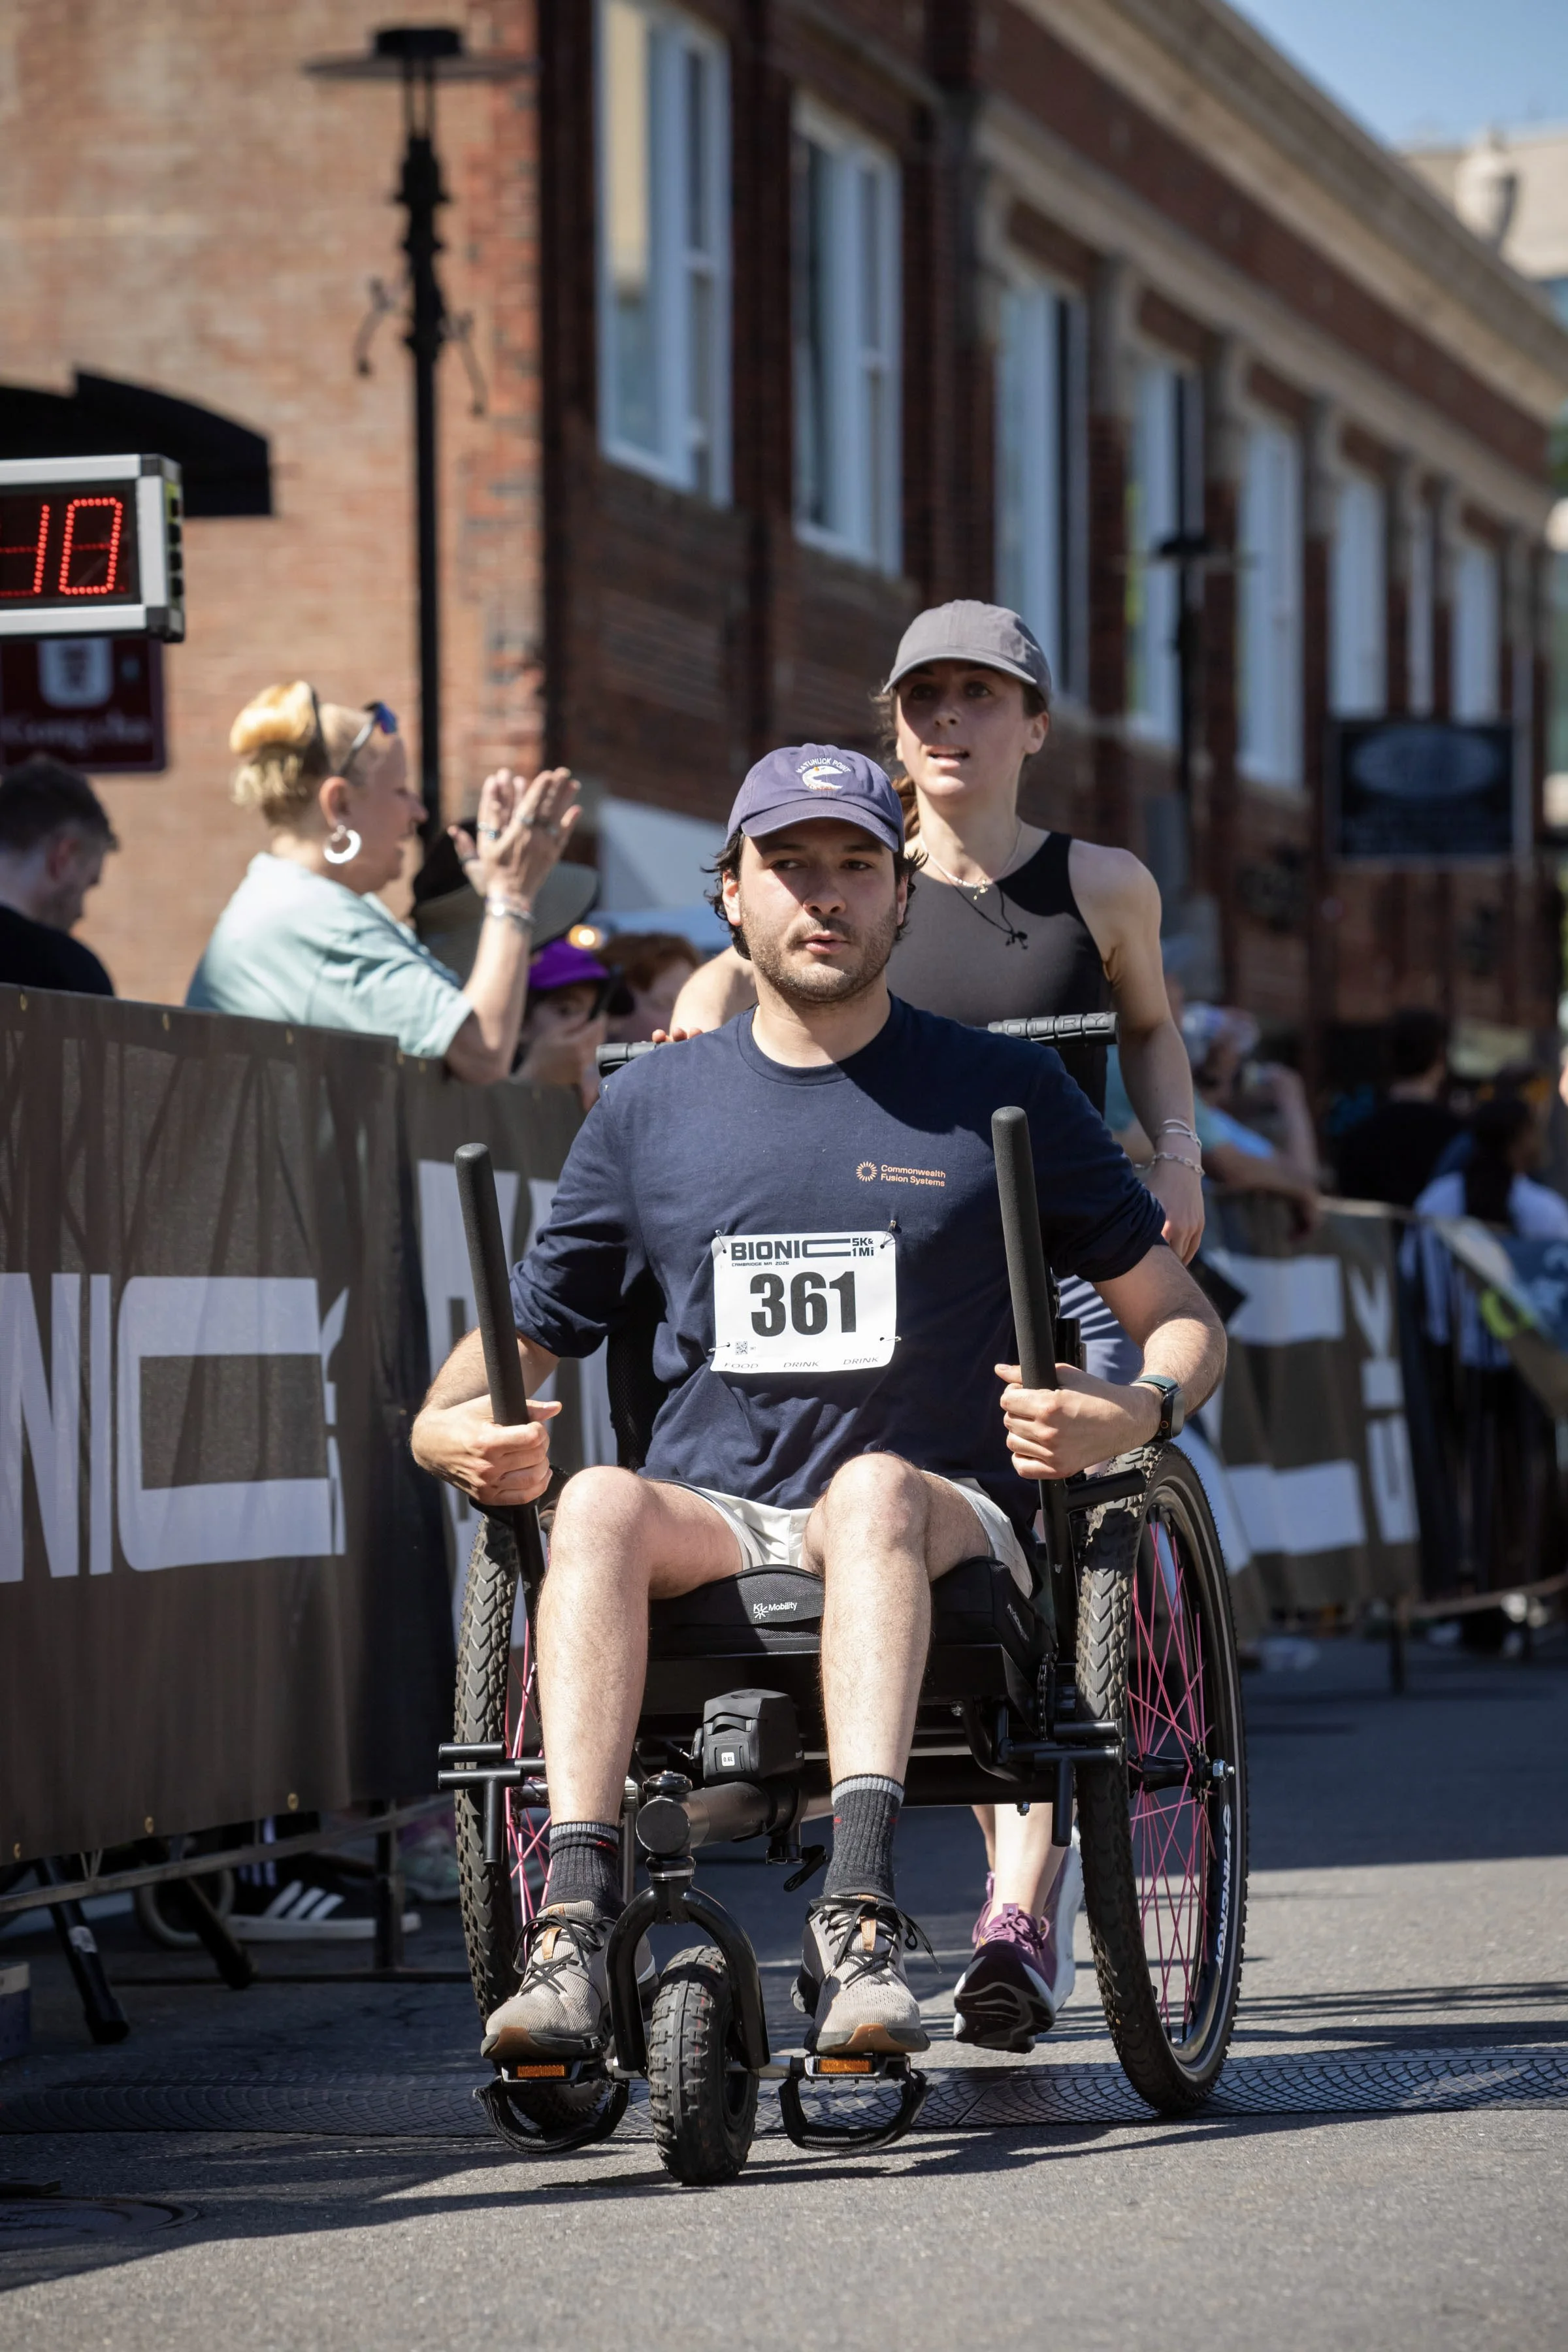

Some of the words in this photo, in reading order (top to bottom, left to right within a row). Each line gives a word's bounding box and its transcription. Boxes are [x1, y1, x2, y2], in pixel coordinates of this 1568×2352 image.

[795, 758, 832, 774] MATUNUCK
[832, 760, 851, 772] POINT
[1007, 1015, 1103, 1034] OURY
[881, 1164, 946, 1179] Commonwealth
[881, 1173, 908, 1183] Fusion
[910, 1176, 945, 1187] Systems
[730, 1238, 851, 1260] BIONIC
[749, 1271, 857, 1337] 361
[843, 1356, 879, 1365] DRINK
[768, 1601, 797, 1611] Mobility
